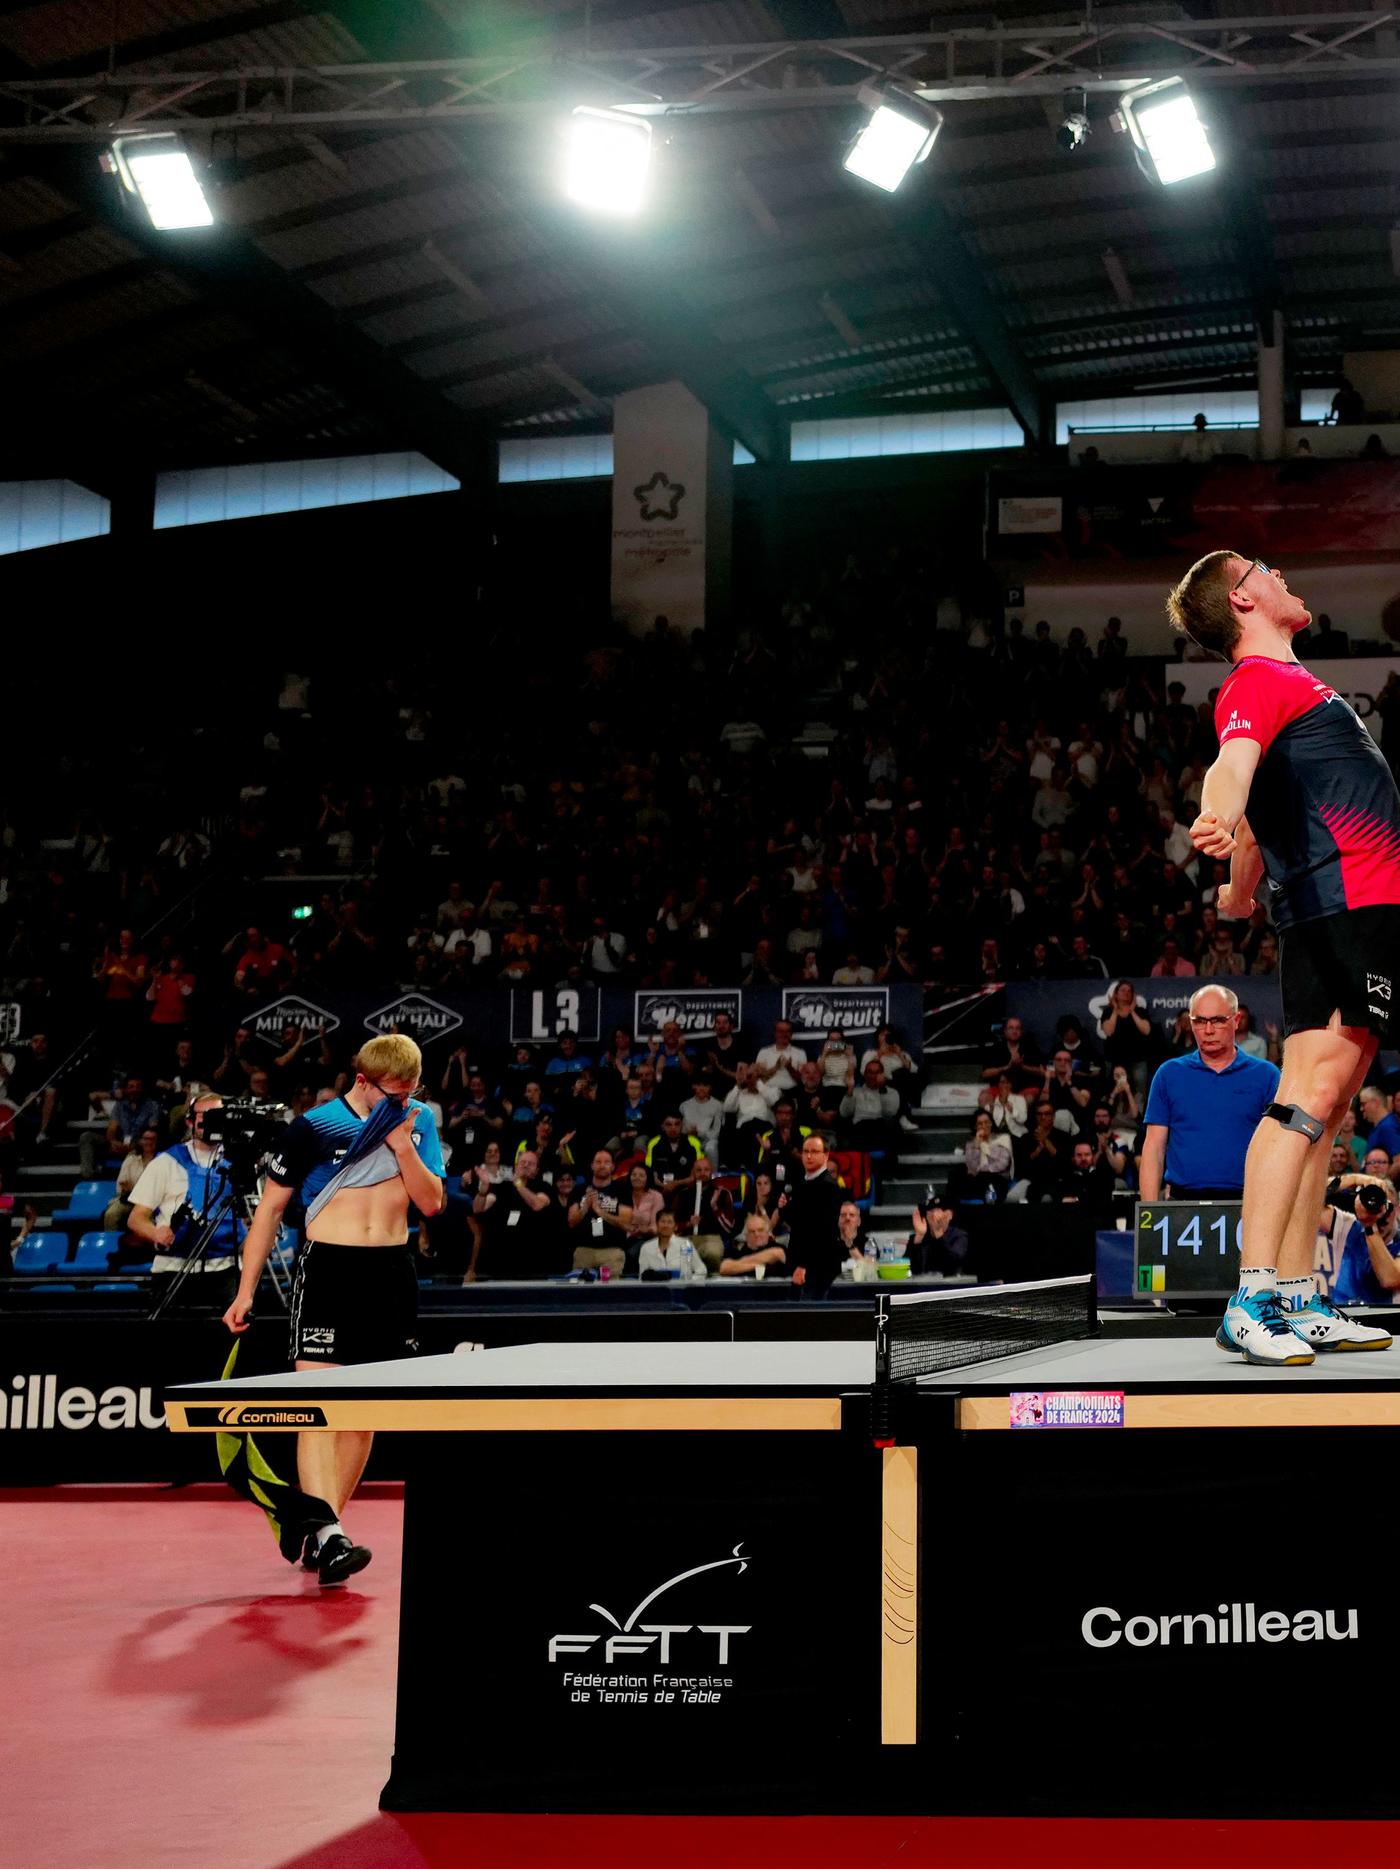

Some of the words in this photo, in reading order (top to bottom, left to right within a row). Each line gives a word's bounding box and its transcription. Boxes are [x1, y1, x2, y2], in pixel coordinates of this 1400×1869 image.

[1008, 590, 1021, 604] P
[531, 988, 580, 1039] L3
[1140, 1211, 1152, 1229] 2
[0, 1374, 168, 1430] illeau
[1046, 1395, 1121, 1410] CHAMPIONNATS
[242, 1412, 315, 1424] cornilleau
[1046, 1410, 1058, 1424] DE
[1060, 1410, 1094, 1424] FRANCE
[1095, 1409, 1121, 1423] 2024
[1081, 1602, 1359, 1648] Cornilleau
[548, 1624, 752, 1664] FFTT
[563, 1672, 647, 1687] Fédération
[653, 1673, 733, 1689] Française
[571, 1690, 591, 1703] de
[597, 1689, 648, 1703] Tennis
[654, 1690, 675, 1703] de
[682, 1689, 722, 1703] Table
